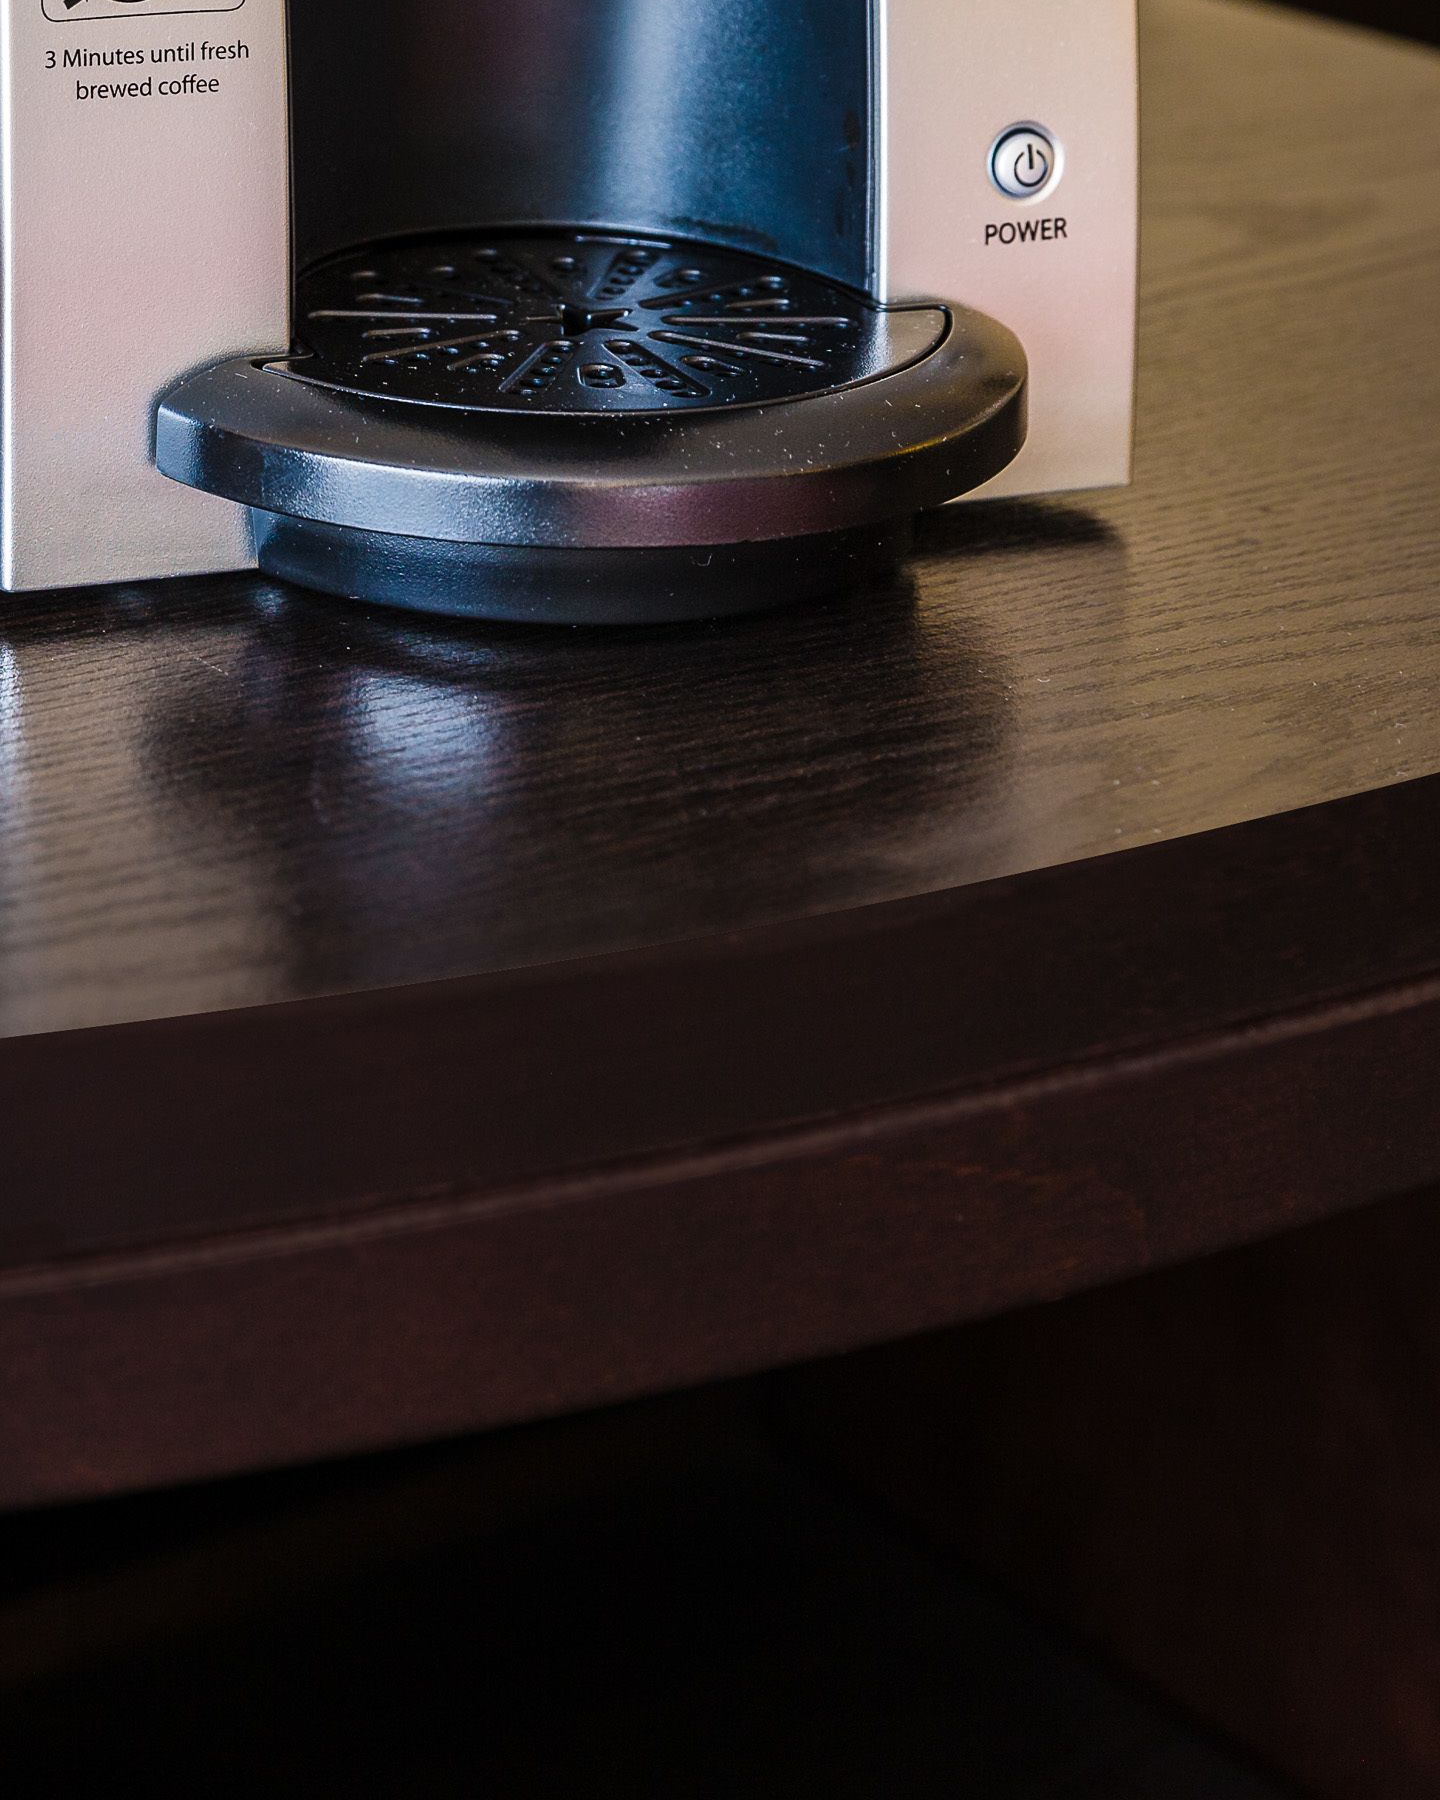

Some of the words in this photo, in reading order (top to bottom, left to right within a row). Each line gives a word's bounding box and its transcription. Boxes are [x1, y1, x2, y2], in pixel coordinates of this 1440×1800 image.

[45, 50, 56, 69] 3
[63, 48, 145, 68] Minutes
[151, 42, 195, 63] until
[200, 40, 249, 60] fresh
[76, 77, 152, 100] brewed
[158, 74, 220, 96] coffee
